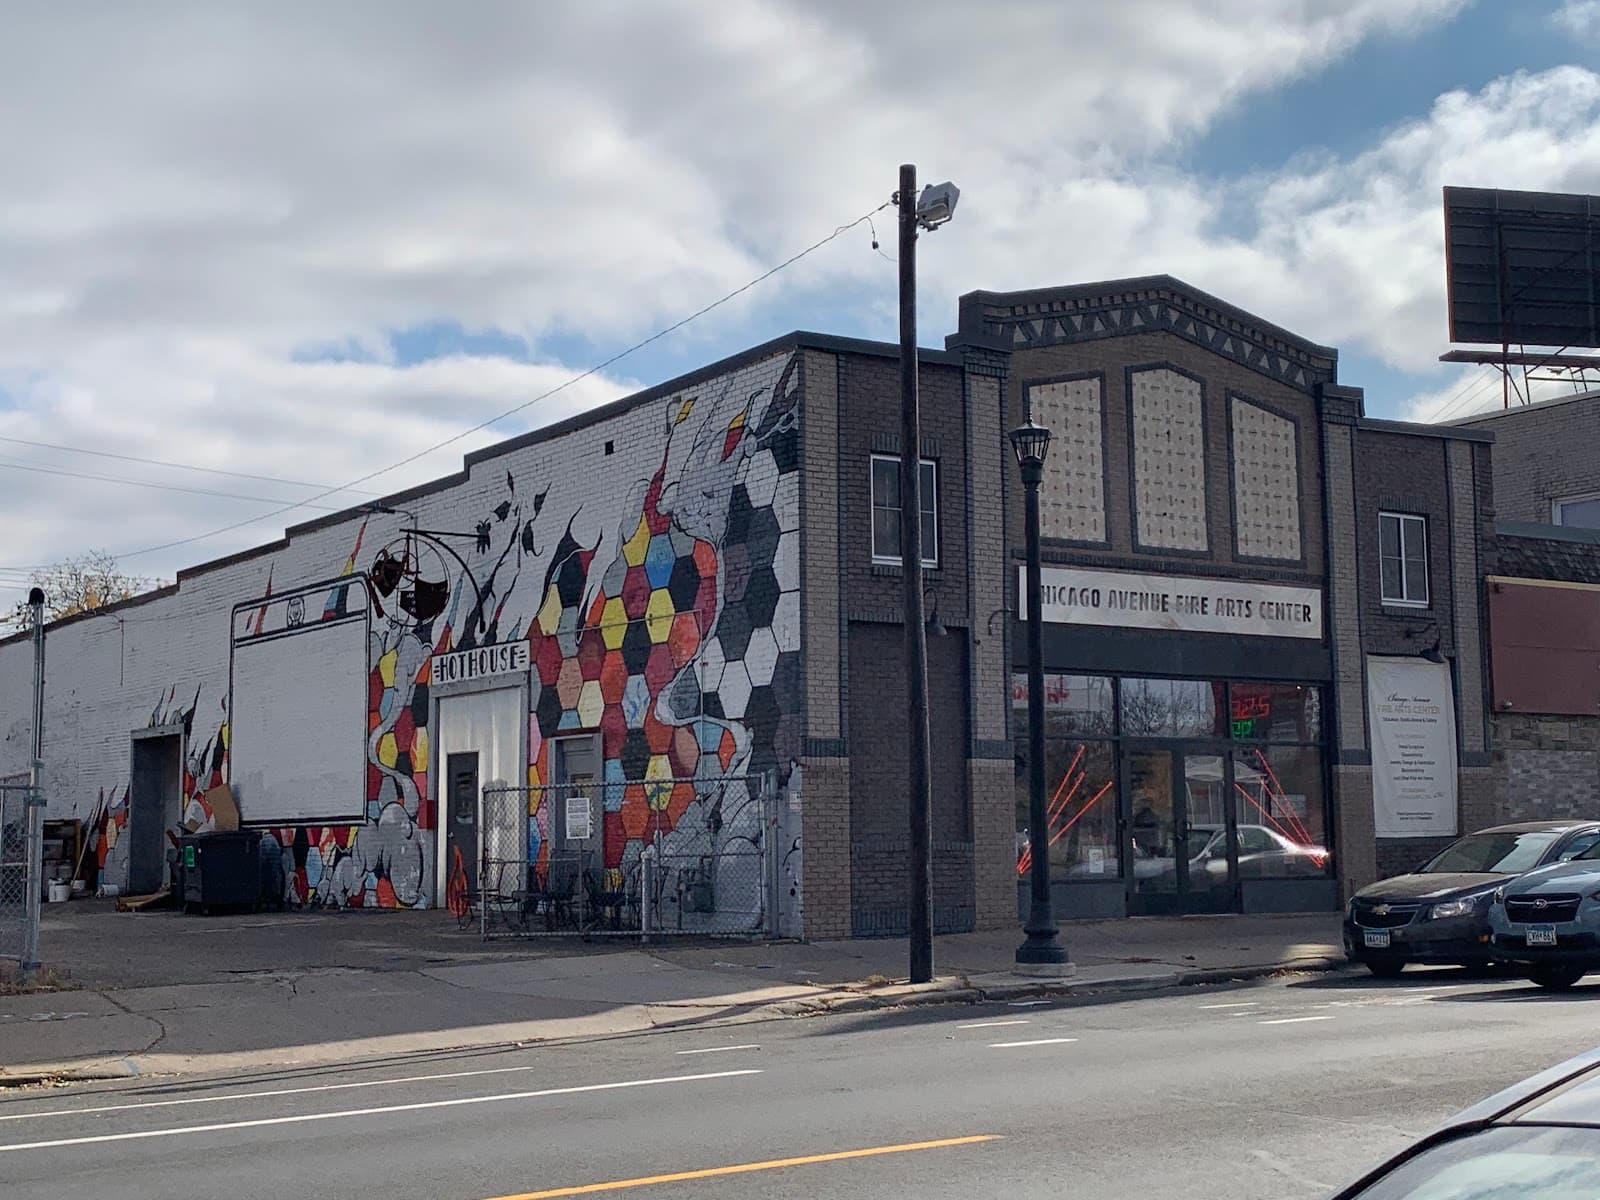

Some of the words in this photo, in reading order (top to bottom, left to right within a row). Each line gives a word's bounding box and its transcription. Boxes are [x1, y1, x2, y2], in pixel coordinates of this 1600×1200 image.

[1041, 585, 1100, 608] HICAGO
[1108, 589, 1169, 612] AVENUE
[1176, 594, 1209, 615] FIRE
[1215, 598, 1252, 618] ARTS
[1259, 601, 1312, 623] CENTER
[440, 645, 519, 682] HOTHOUSE
